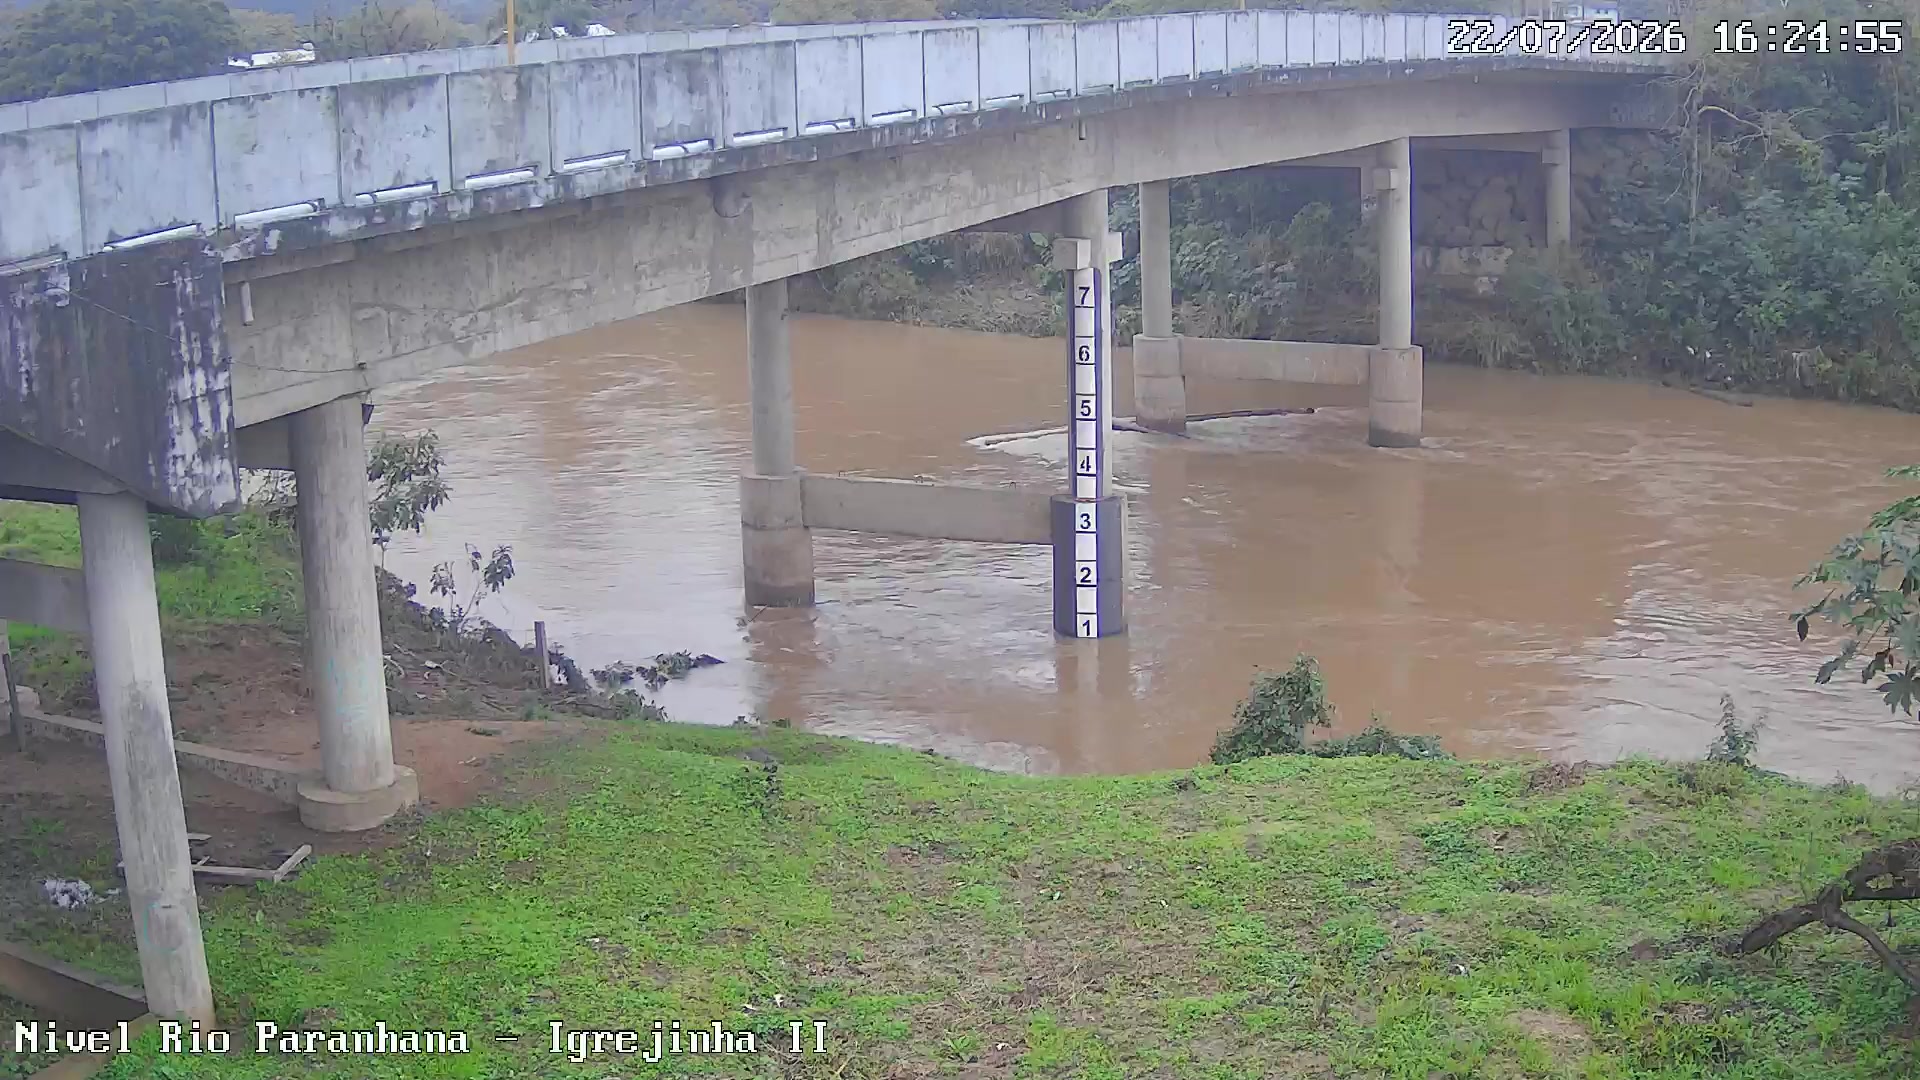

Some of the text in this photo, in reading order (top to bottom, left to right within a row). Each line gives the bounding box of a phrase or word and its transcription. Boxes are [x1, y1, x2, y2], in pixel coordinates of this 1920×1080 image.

[1078, 286, 1090, 305] 7
[1078, 345, 1090, 362] 6
[1080, 399, 1092, 417] 5
[1079, 455, 1092, 472] 4
[1079, 512, 1092, 530] 3
[1079, 566, 1092, 584] 2
[1082, 619, 1091, 637] 1
